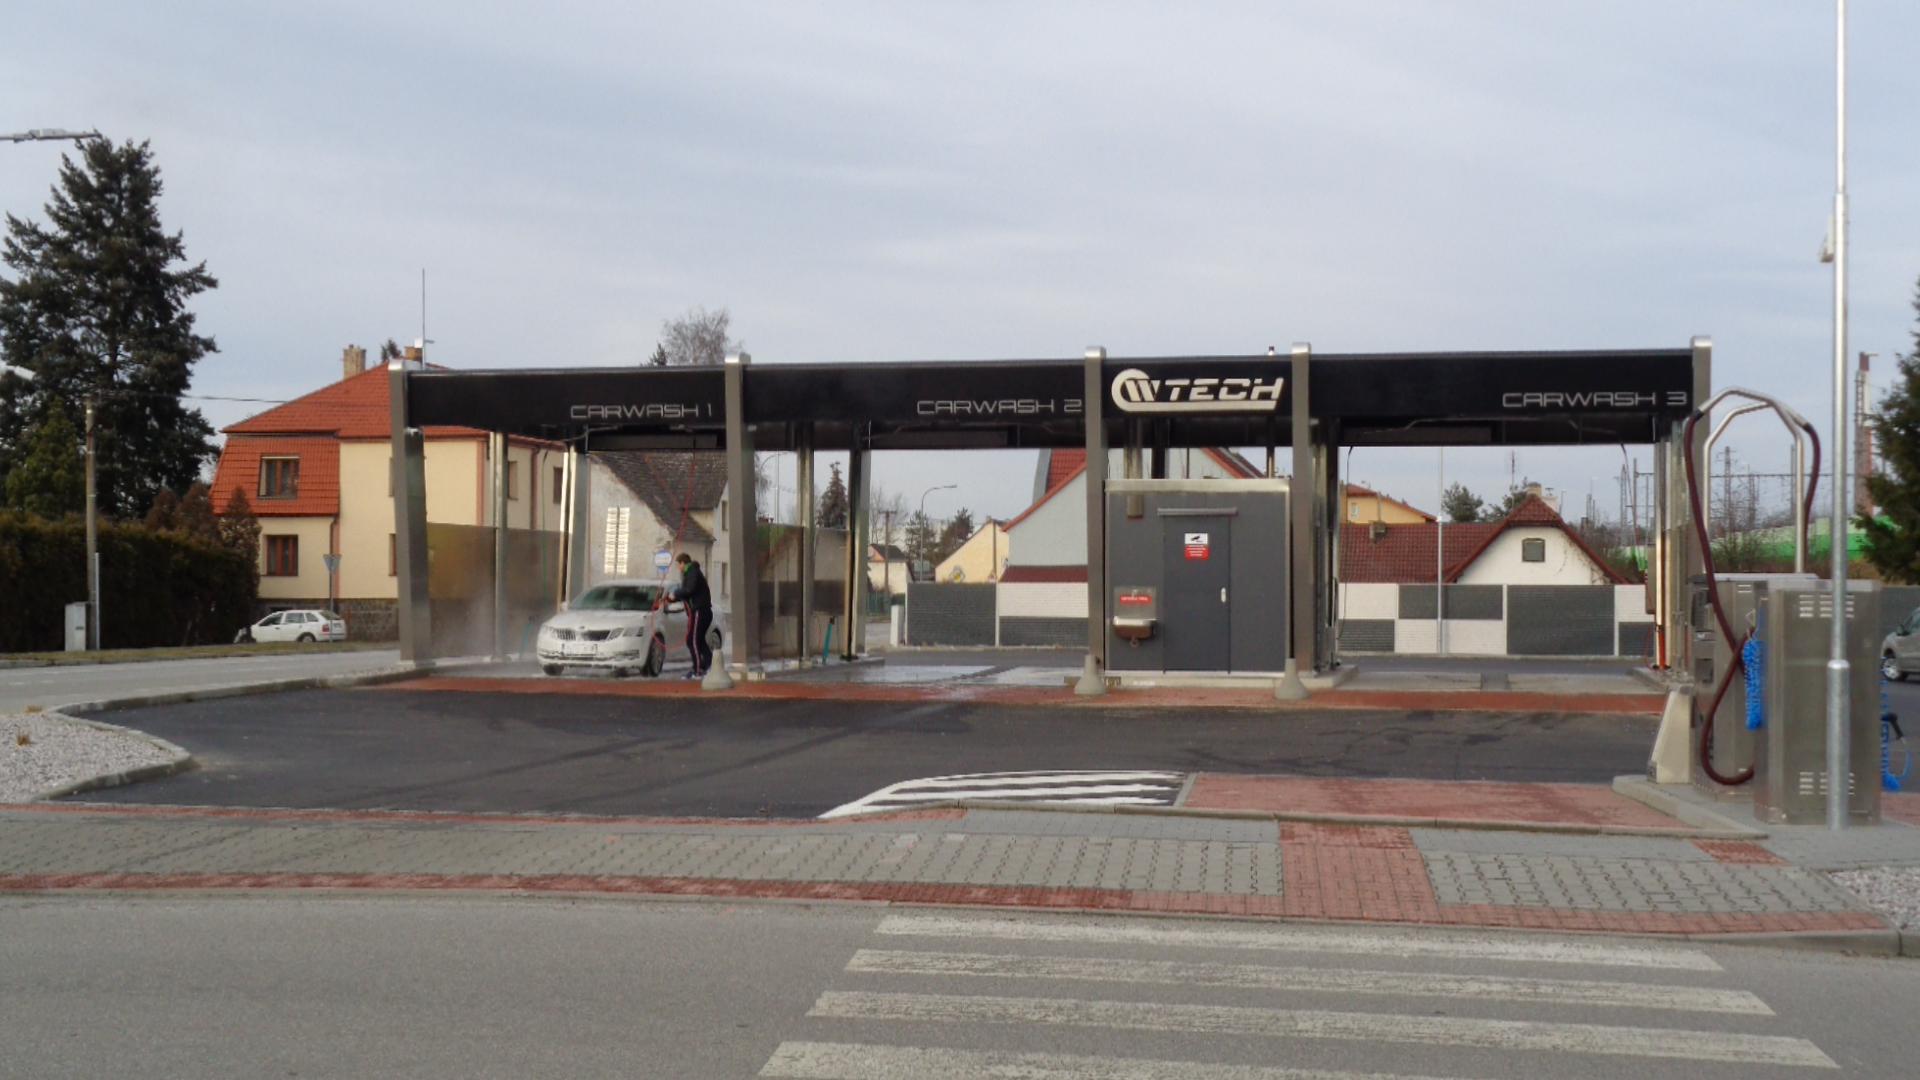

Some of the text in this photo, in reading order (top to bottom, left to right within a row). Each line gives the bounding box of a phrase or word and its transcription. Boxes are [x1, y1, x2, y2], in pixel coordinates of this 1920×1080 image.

[917, 398, 1083, 415] CARWASH 2
[1502, 391, 1688, 408] CARWASH 3
[570, 402, 713, 419] CARWASH 1
